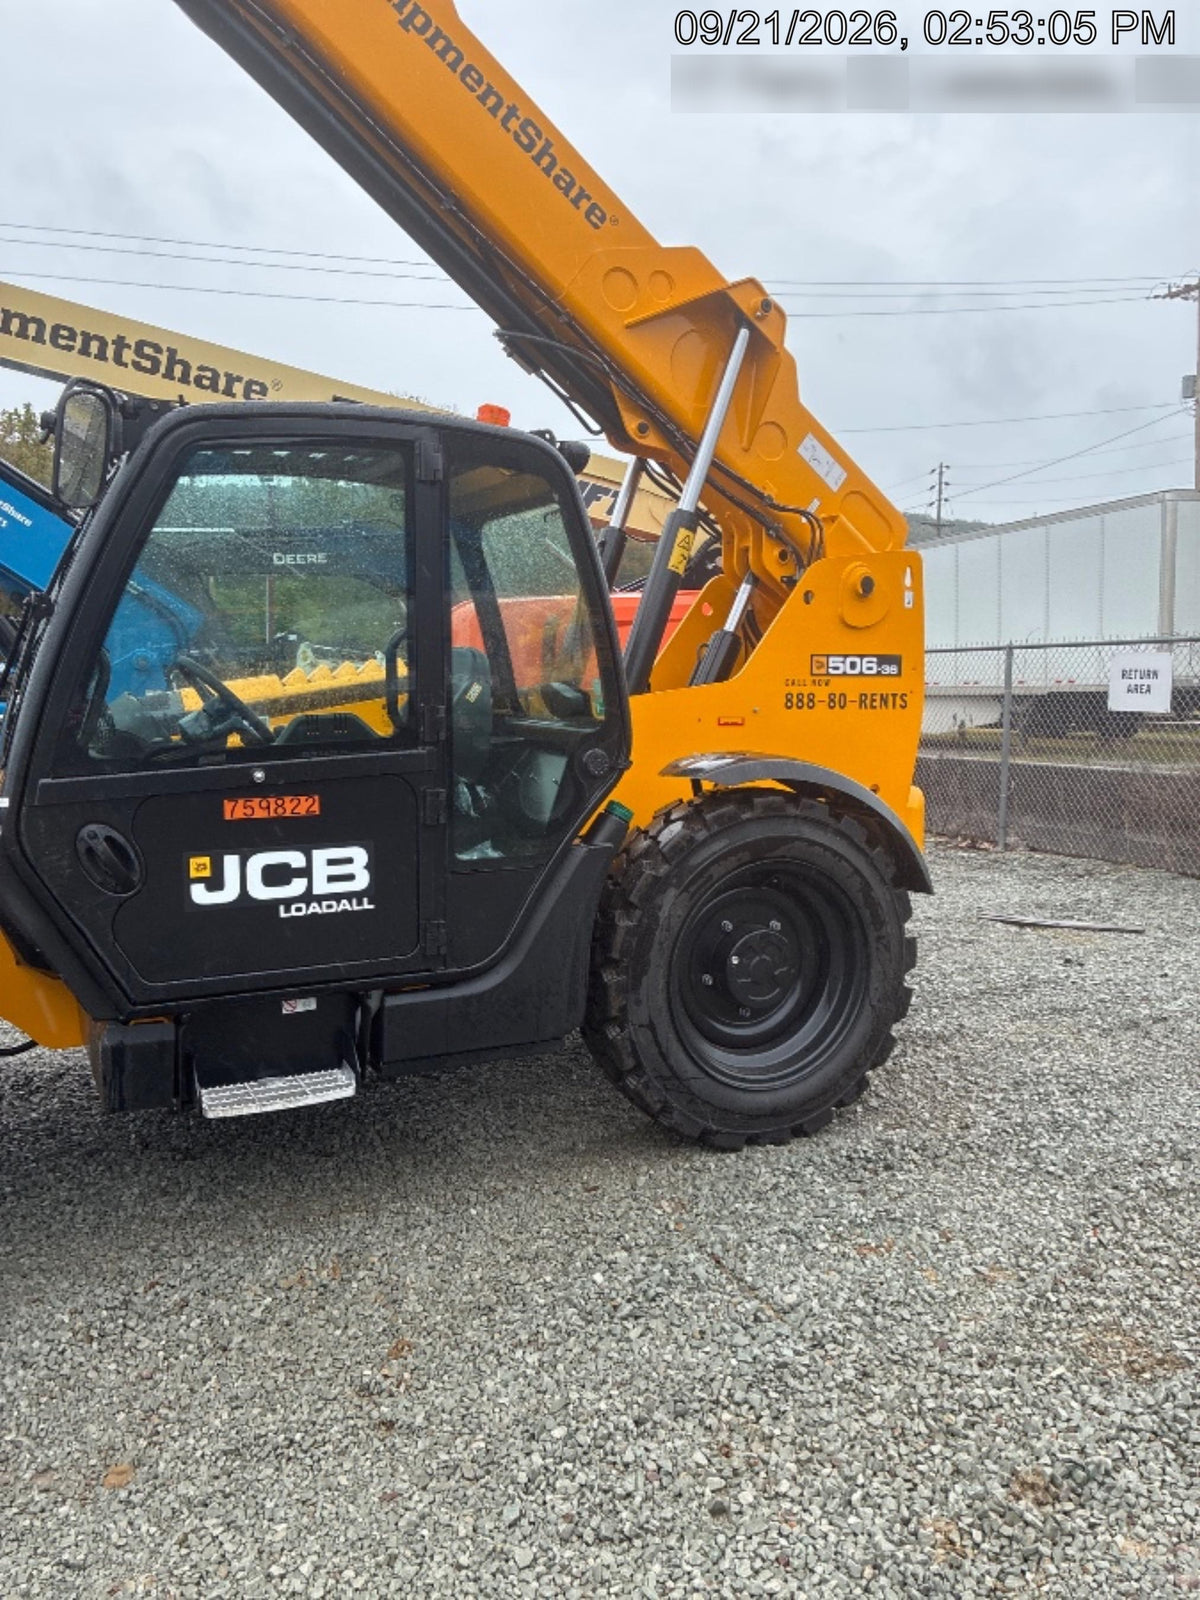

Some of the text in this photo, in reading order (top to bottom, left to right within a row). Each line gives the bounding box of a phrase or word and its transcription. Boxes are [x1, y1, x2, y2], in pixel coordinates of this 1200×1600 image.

[273, 552, 328, 565] DEERE
[1121, 669, 1159, 680] RETURN
[785, 678, 831, 687] CALL NOW
[1126, 683, 1151, 695] AREA
[784, 692, 909, 710] 888-80-RENTS
[226, 796, 317, 818] 759822
[190, 846, 371, 905] JCB
[279, 897, 376, 918] LOADALL
